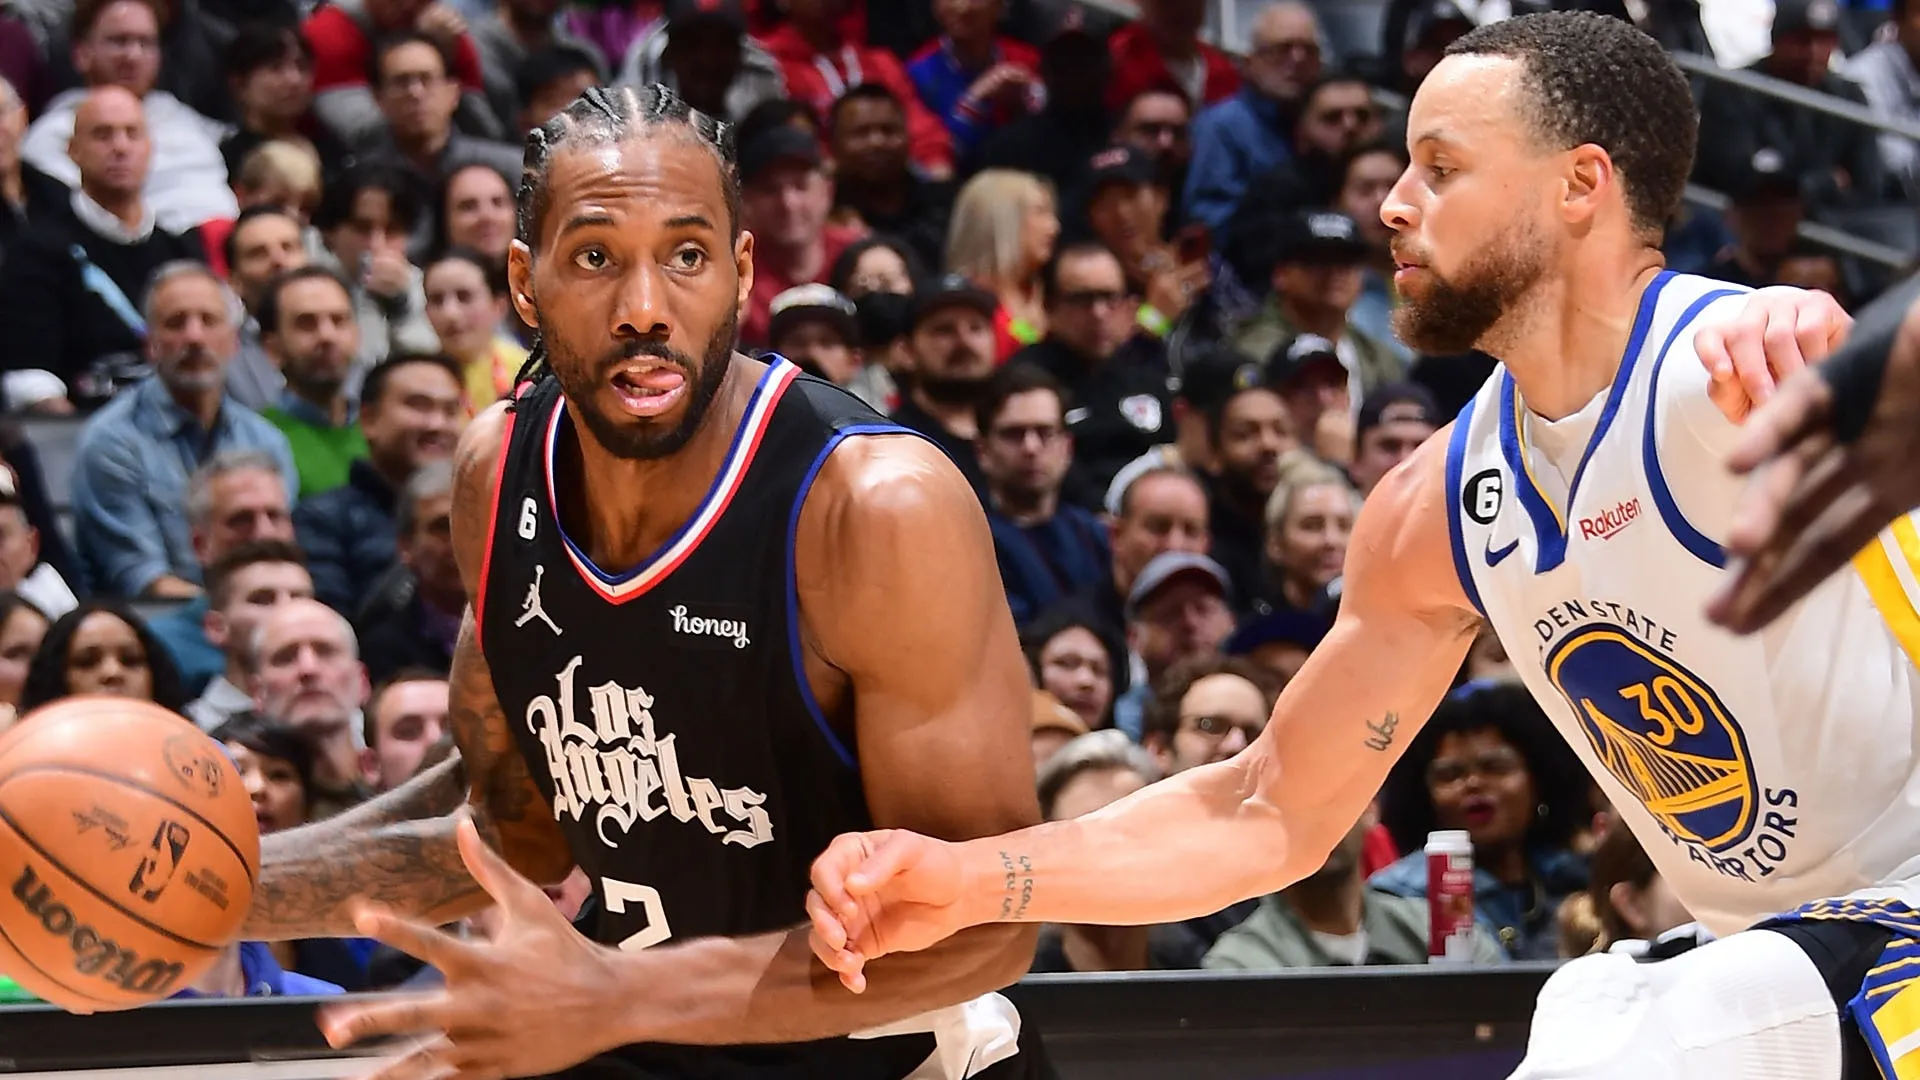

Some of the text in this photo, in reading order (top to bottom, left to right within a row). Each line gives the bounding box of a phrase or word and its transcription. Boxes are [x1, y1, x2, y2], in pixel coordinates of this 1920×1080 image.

[517, 497, 538, 540] 6
[1475, 475, 1501, 518] 6
[1578, 498, 1642, 541] Rakuten
[669, 604, 750, 648] honey
[1534, 599, 1678, 652] DEN STATE
[555, 656, 658, 756] Los
[1617, 675, 1704, 746] 30
[526, 694, 775, 849] Angeles
[11, 864, 185, 994] Wilson
